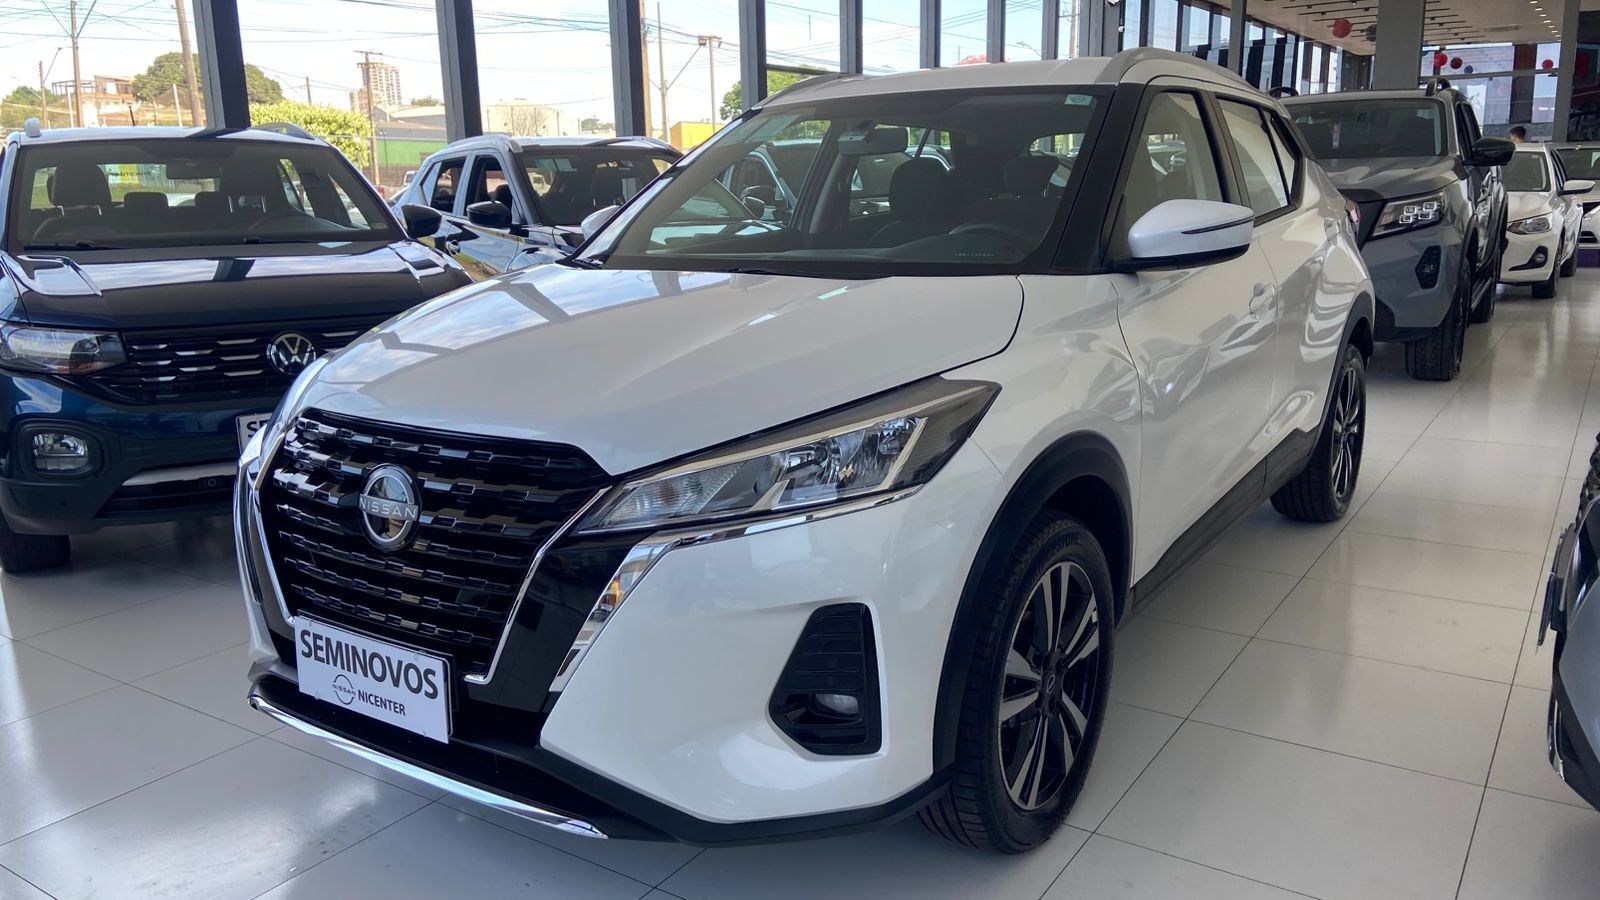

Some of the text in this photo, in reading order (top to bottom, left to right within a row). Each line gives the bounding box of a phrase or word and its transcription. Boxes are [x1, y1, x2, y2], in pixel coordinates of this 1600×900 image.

[359, 496, 417, 518] NISSAN
[300, 629, 439, 700] SEMINOVOS
[332, 683, 406, 716] NISSAN NICENTER
